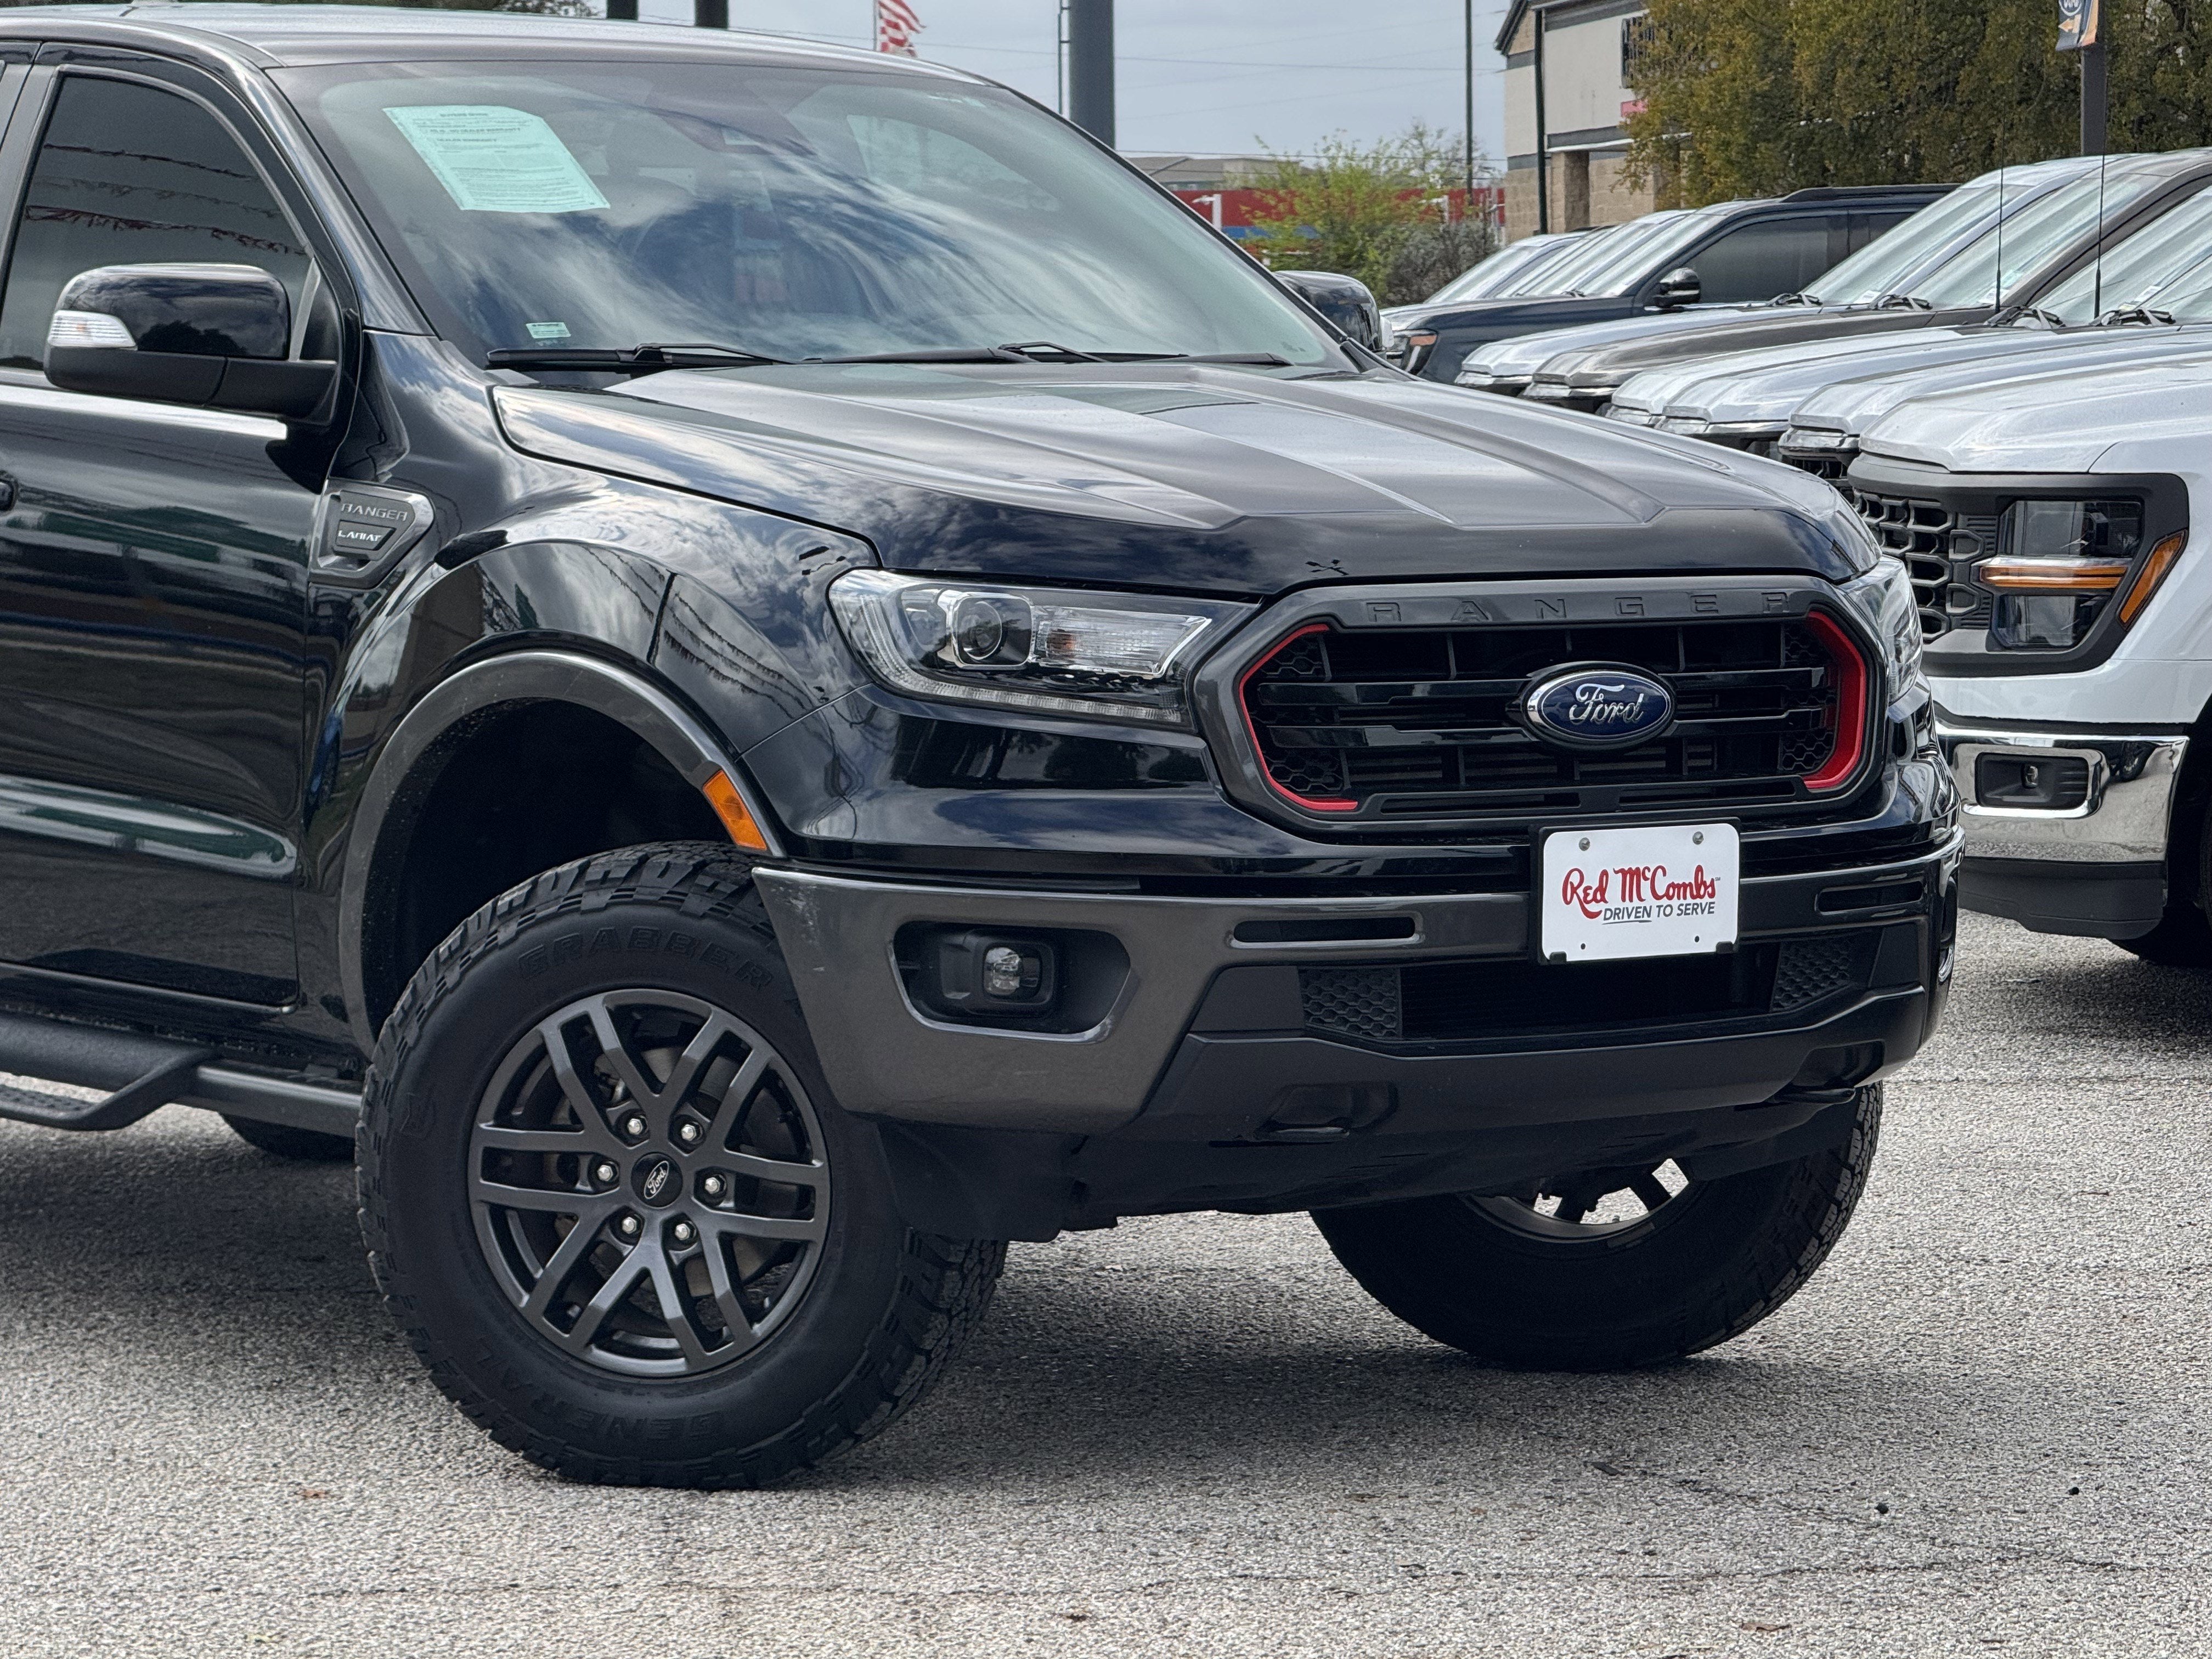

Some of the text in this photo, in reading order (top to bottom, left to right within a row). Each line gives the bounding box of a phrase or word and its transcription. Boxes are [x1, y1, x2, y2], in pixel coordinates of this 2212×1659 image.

[341, 503, 408, 522] RANGER
[338, 530, 382, 542] LARIAT
[1365, 591, 1793, 623] RANGER
[1570, 683, 1644, 725] Ford
[1561, 867, 1610, 919] Red
[1613, 865, 1716, 903] McCombs
[1603, 901, 1716, 921] DRIVEN TO SERVE
[518, 925, 775, 991] GRABBER
[647, 1166, 666, 1194] Ford
